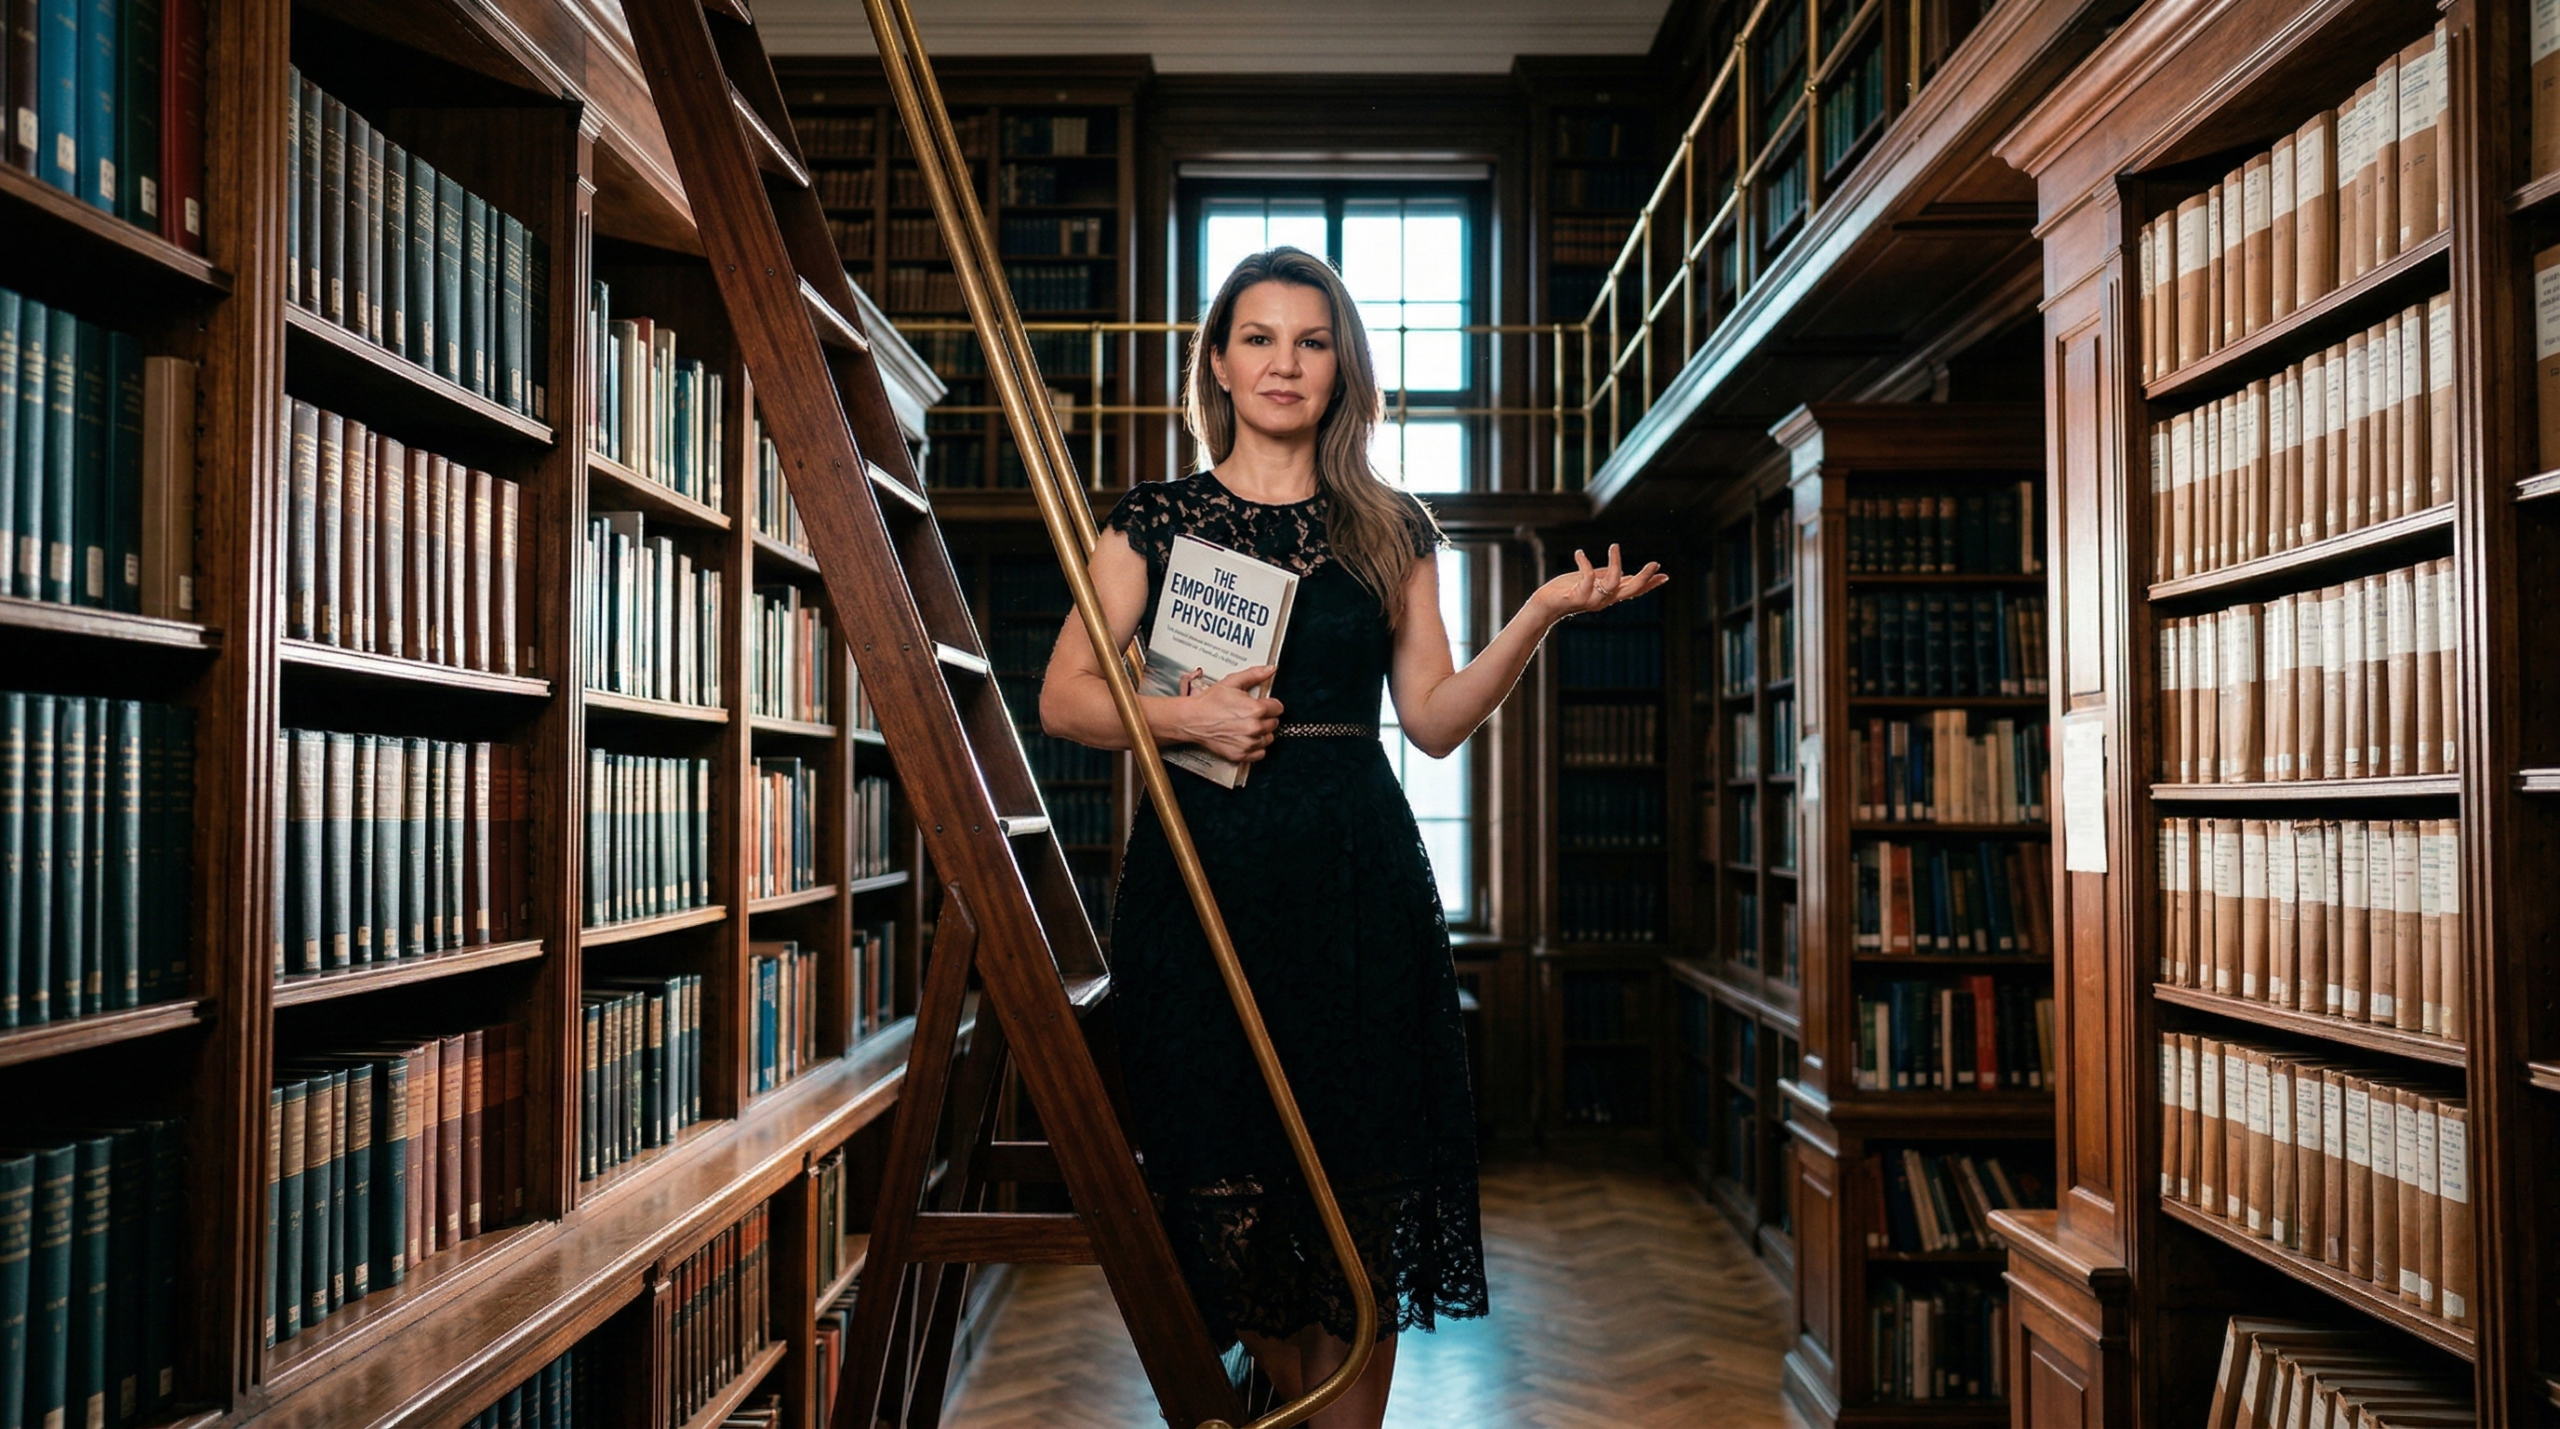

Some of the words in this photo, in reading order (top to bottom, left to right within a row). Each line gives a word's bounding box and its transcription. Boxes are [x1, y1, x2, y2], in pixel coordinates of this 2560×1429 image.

[1171, 573, 1269, 626] EMPOWERED
[1214, 568, 1237, 590] THE
[1172, 600, 1255, 648] PHYSICIAN
